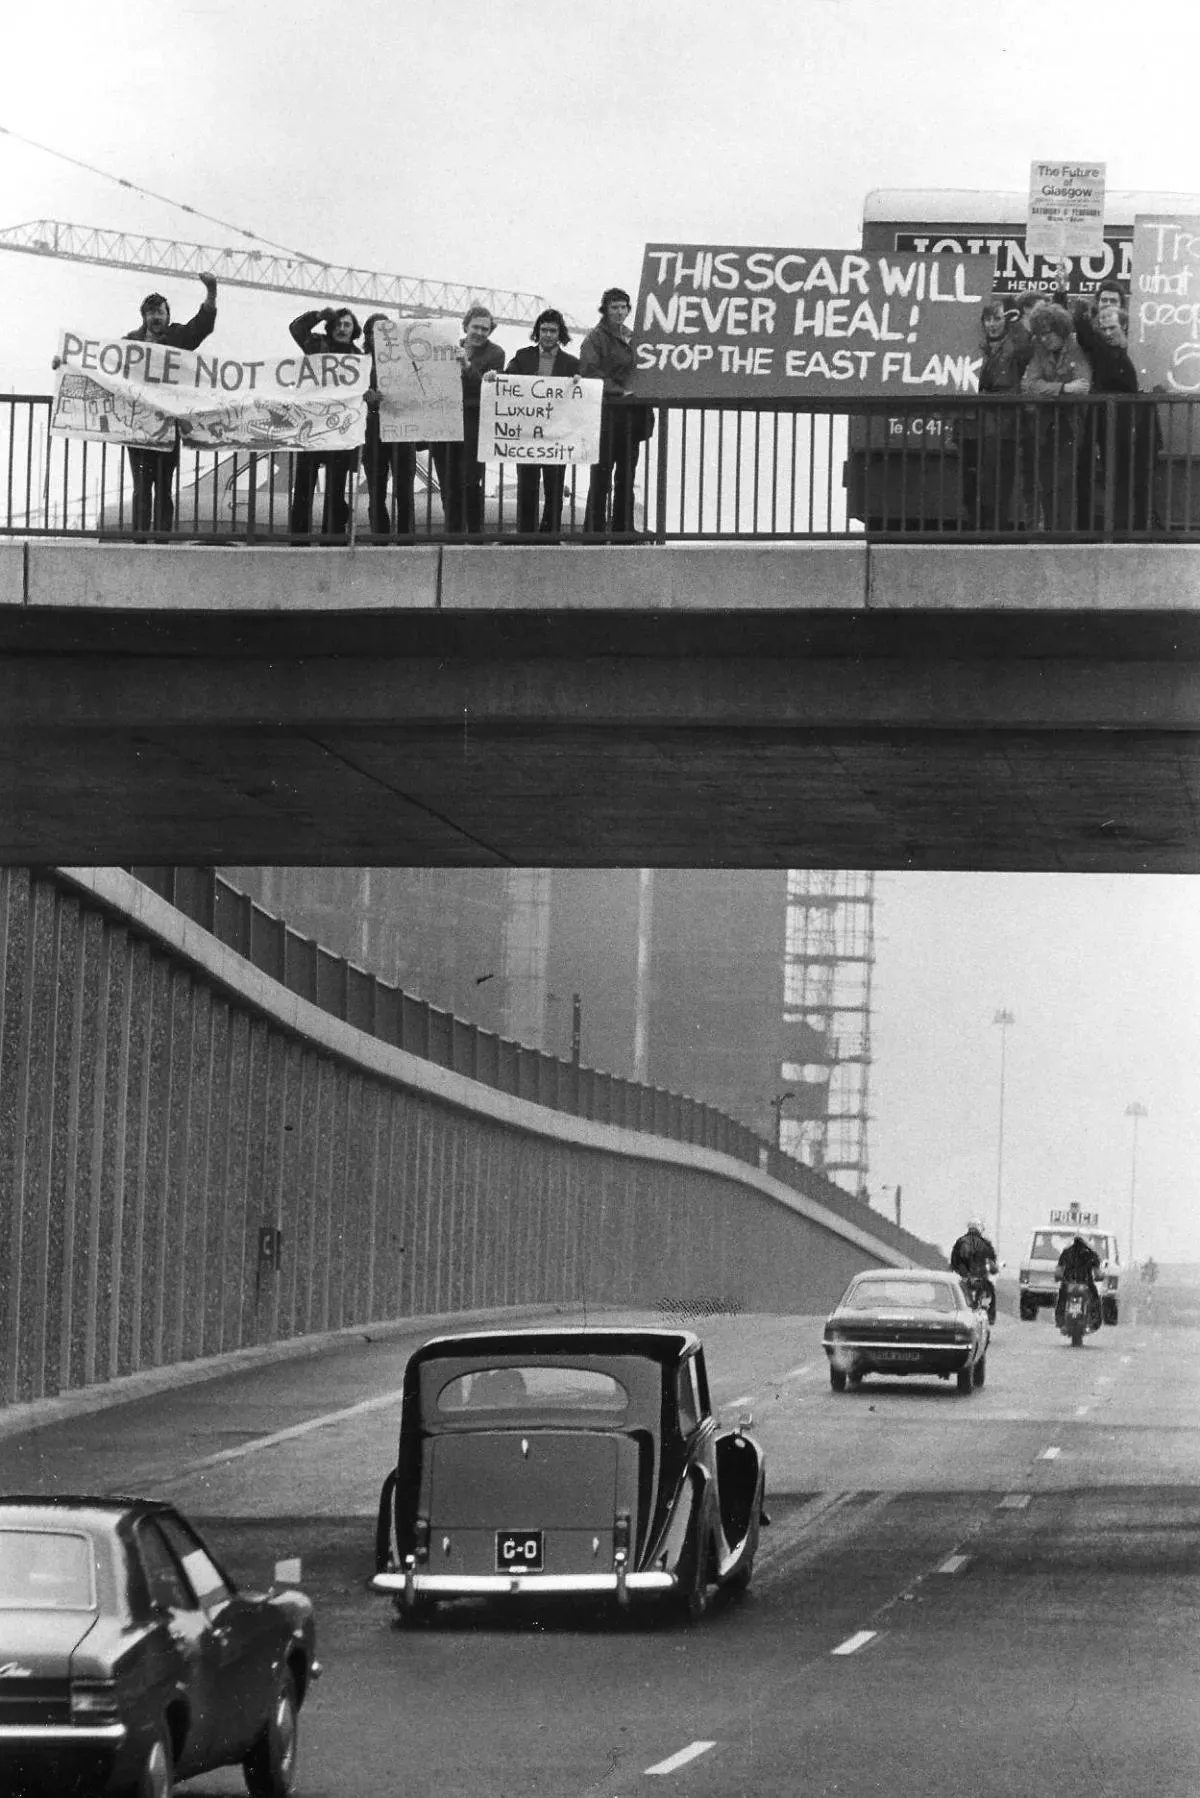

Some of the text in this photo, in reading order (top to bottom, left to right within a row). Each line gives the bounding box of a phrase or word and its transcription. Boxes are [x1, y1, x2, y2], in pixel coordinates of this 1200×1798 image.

[1038, 165, 1100, 178] The Future
[1041, 184, 1093, 199] Glasgow
[648, 251, 983, 303] THIS SCAR WILL
[642, 292, 920, 344] NEVER HEAL!
[61, 332, 182, 385] PEOPLE
[195, 357, 265, 391] NOT
[275, 354, 361, 388] CARS
[636, 343, 984, 394] STOP THE EAST FLANK
[572, 385, 583, 400] A
[533, 425, 544, 439] A
